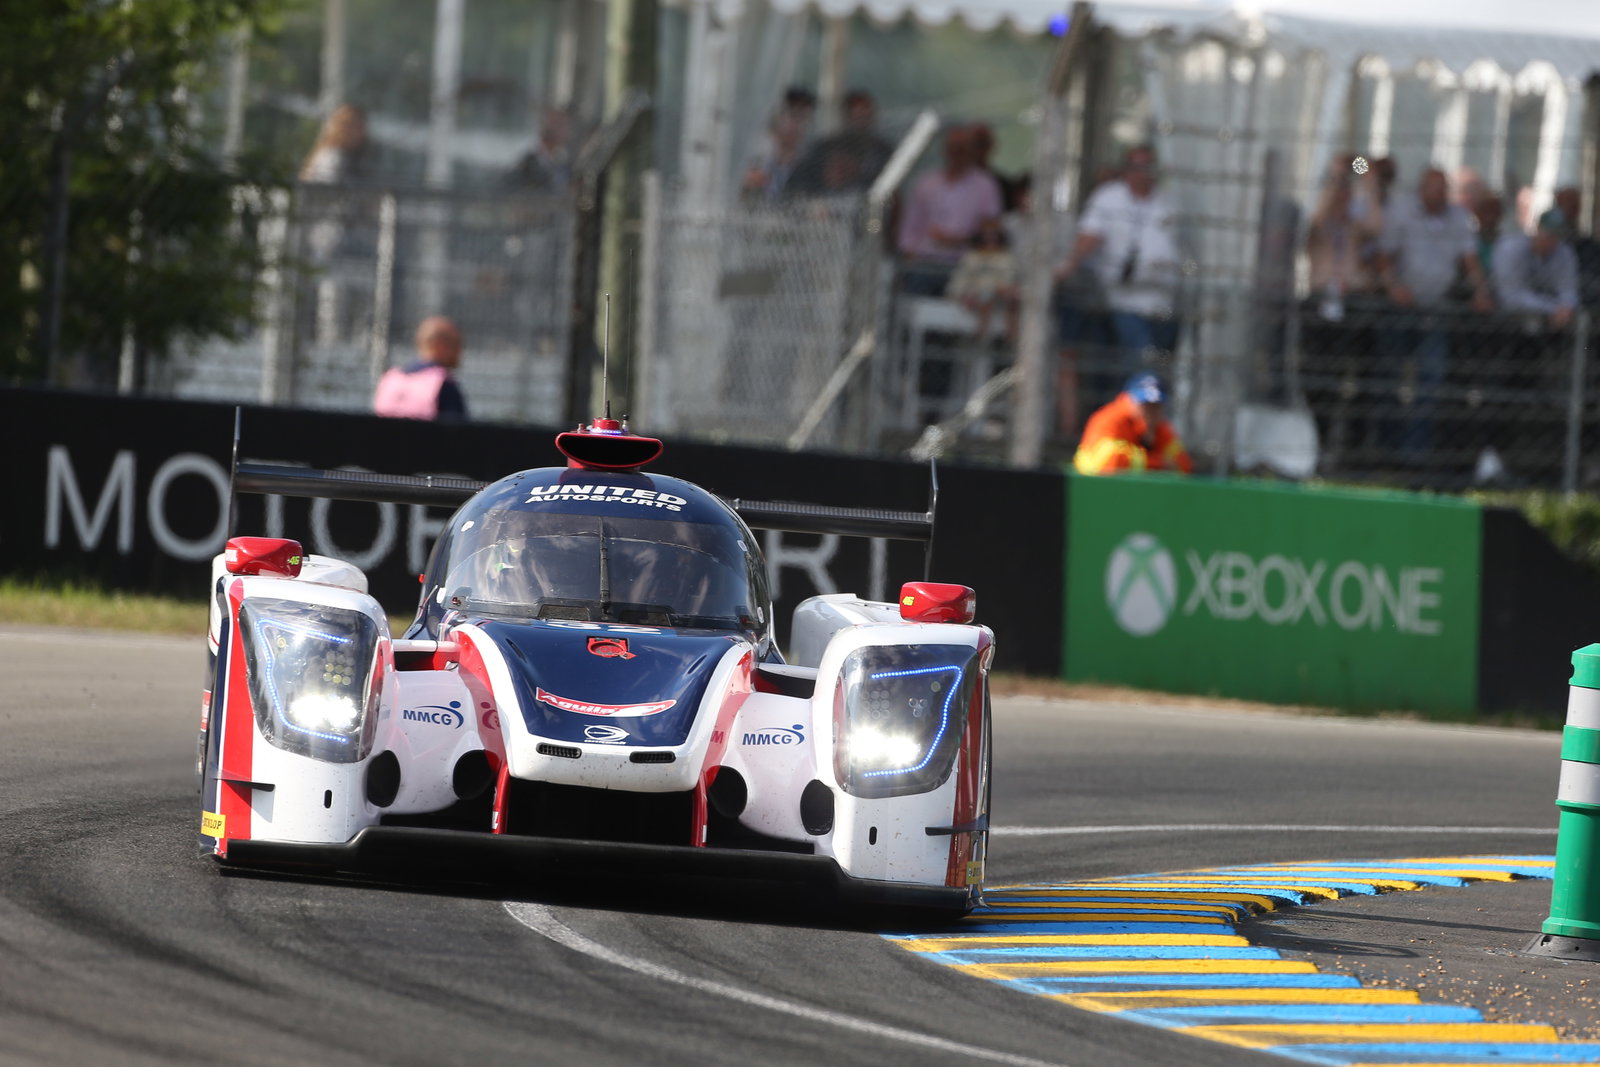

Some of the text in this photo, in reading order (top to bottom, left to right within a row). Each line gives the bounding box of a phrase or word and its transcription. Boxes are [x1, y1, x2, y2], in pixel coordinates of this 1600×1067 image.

[524, 494, 682, 512] AUTOSPORTS
[530, 484, 688, 506] UNITED
[1182, 548, 1443, 637] XBOX ONE
[403, 709, 452, 726] MMCG
[742, 733, 793, 746] MMCG
